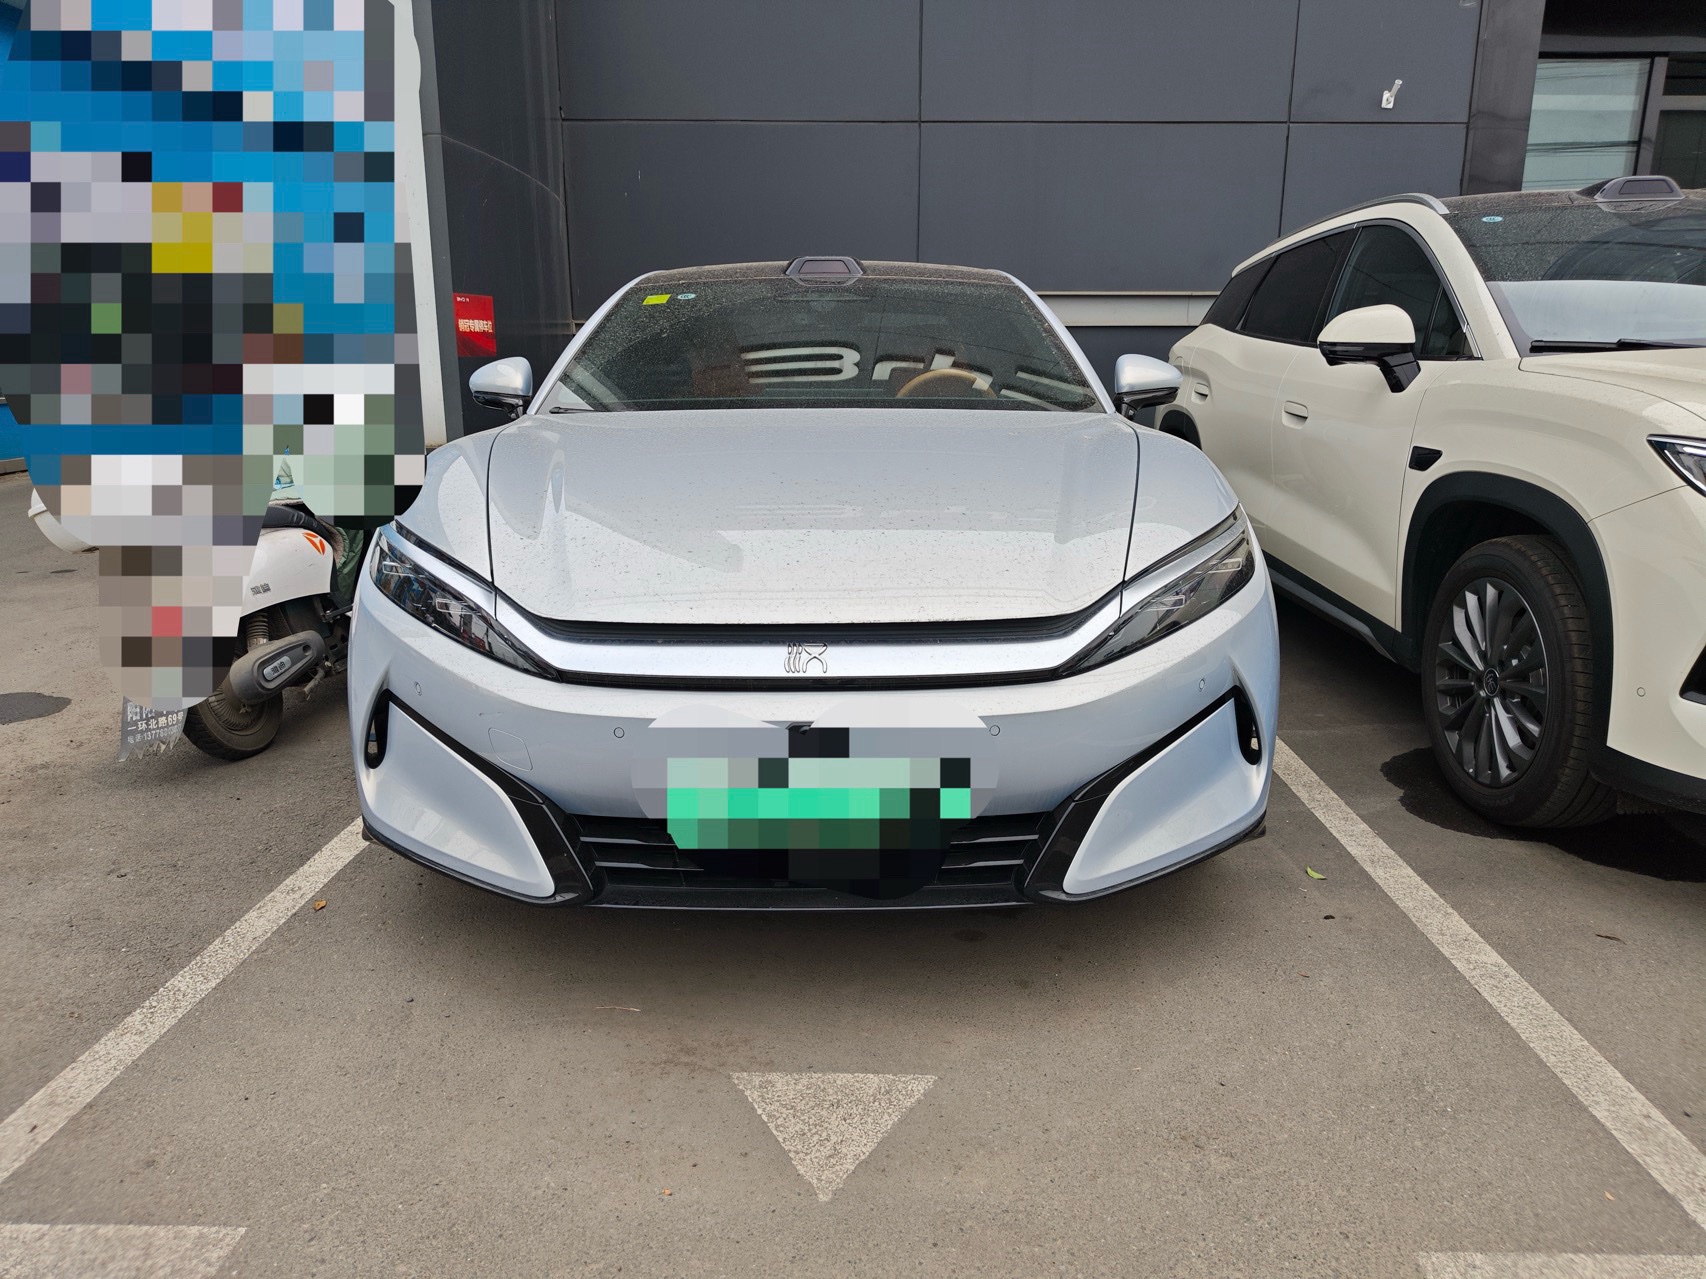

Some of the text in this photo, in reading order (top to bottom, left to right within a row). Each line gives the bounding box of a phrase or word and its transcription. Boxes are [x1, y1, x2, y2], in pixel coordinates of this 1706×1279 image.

[127, 712, 184, 731] 一环北路69号
